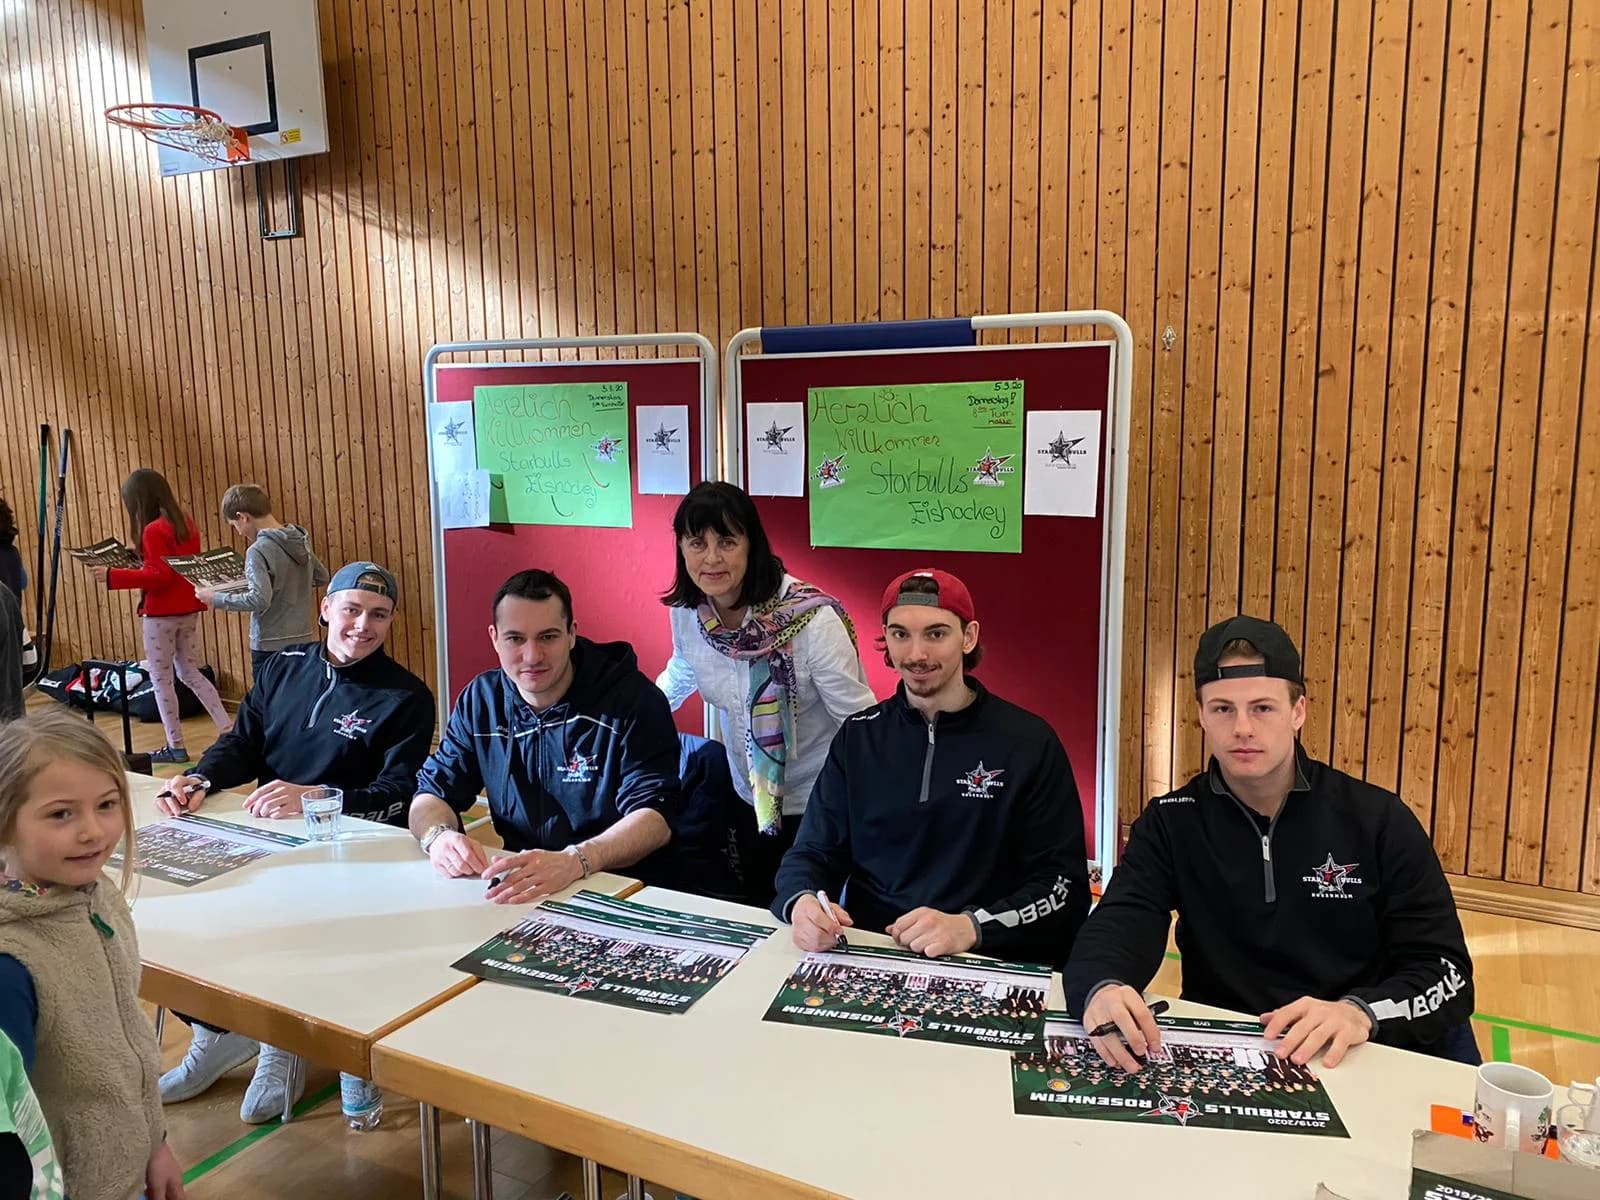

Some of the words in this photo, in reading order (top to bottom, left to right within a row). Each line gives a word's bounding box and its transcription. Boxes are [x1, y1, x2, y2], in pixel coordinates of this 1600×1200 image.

[812, 389, 933, 425] Herzlich
[867, 457, 969, 495] Starbulls
[909, 501, 1007, 539] Eishockey
[481, 957, 570, 984] ROSENHEIM
[599, 982, 691, 1004] STARBULLS
[781, 1004, 886, 1025] ROSENHEIM
[927, 1022, 1036, 1041] STARBULLS
[976, 1035, 1027, 1045] 2019/2020
[1029, 1091, 1153, 1109] ROSENHEIM
[1204, 1104, 1331, 1122] STARBULLS
[1267, 1118, 1327, 1128] 2019/2020
